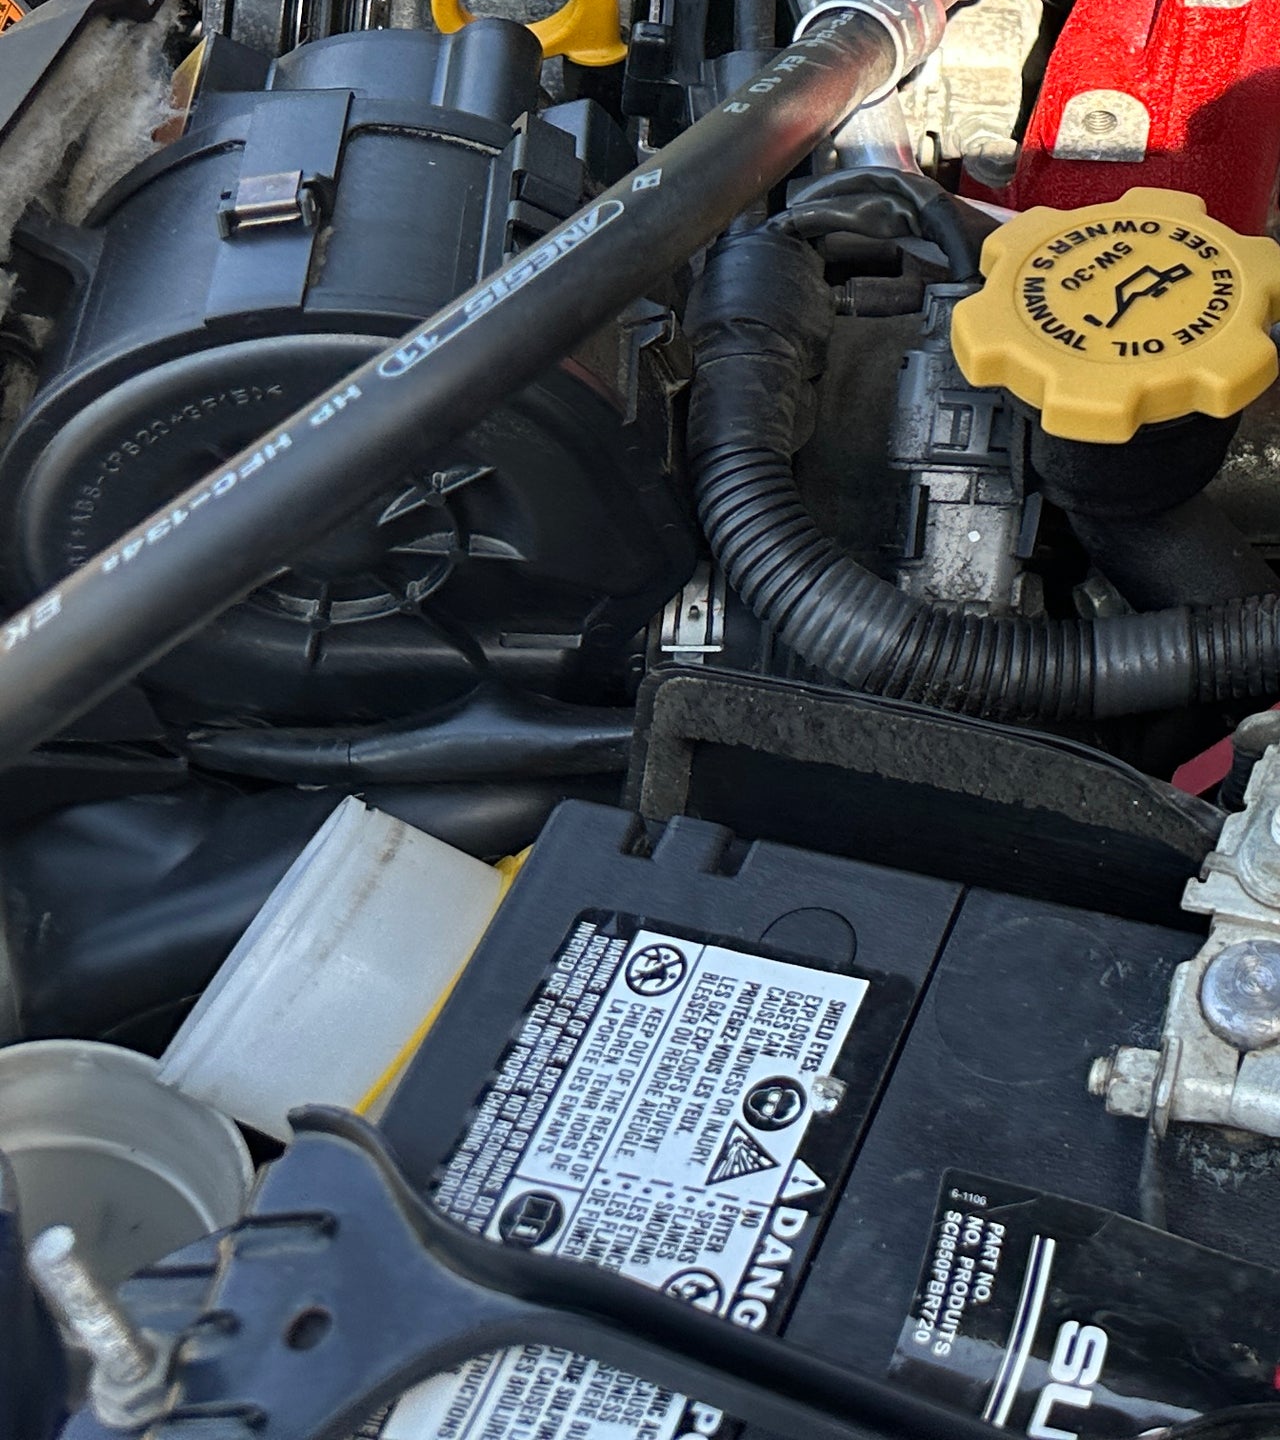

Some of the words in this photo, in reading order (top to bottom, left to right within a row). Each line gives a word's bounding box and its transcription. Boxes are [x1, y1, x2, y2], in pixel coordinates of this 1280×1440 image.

[1032, 220, 1161, 270] OWNER'S
[1168, 227, 1219, 259] SEE
[1023, 276, 1087, 351] MANUAL
[1172, 268, 1232, 345] ENGINE
[1111, 338, 1164, 356] OIL
[306, 381, 362, 429] HP
[99, 430, 294, 575] HFC-134a
[557, 921, 596, 971] INVERTED
[559, 935, 608, 1007] DISASSEMBLE
[712, 976, 738, 999] LES
[549, 1006, 571, 1025] OR
[574, 991, 600, 1018] RISK
[604, 996, 627, 1015] LA
[679, 972, 718, 1026] BLESSER
[701, 1000, 725, 1026] GAZ
[752, 986, 784, 1027] CAUSE
[772, 990, 803, 1030] GASES
[813, 998, 845, 1041] SHIELD
[518, 996, 555, 1046] FOLLOW
[565, 1018, 585, 1036] OF
[598, 1002, 646, 1066] CHILDREN.
[636, 1006, 665, 1039] KEEP
[669, 1026, 693, 1046] OU
[778, 994, 823, 1060] EXPLOSIVE
[622, 1038, 648, 1067] OUT
[667, 1026, 712, 1093] EXPLOSIFS
[719, 1026, 765, 1095] BLINDNESS
[759, 1031, 785, 1058] CAN
[494, 1044, 530, 1091] PROPER
[565, 1065, 590, 1092] DES
[612, 1067, 634, 1088] OF
[644, 1046, 682, 1098] RENDRE
[691, 1075, 716, 1099] LES
[500, 1093, 526, 1120] NOT
[515, 1065, 562, 1131] EXPLOSION
[579, 1071, 611, 1111] TENIR
[599, 1087, 624, 1115] THE
[710, 1095, 733, 1116] OR
[461, 1090, 506, 1152] CHARGING
[532, 1093, 577, 1155] ENFANTS.
[558, 1111, 591, 1152] HORS
[613, 1097, 657, 1159] AVEUGLE.
[639, 1094, 681, 1153] PEUVENT
[673, 1101, 704, 1134] YEUX.
[506, 1130, 528, 1151] OR
[575, 1115, 611, 1162] REACH
[686, 1117, 724, 1165] INJURY.
[452, 1120, 513, 1213] RECOMMENDED
[547, 1152, 570, 1173] DE
[565, 1161, 587, 1184] OF
[471, 1195, 496, 1219] DO
[585, 1187, 610, 1207] DE
[603, 1192, 631, 1218] LES
[623, 1196, 652, 1223] LES
[563, 1208, 600, 1256] FUMER
[629, 1200, 675, 1267] SMOKING
[654, 1204, 695, 1261] FLAMES
[676, 1209, 716, 1265] SPARKS
[739, 1208, 763, 1229] NO
[960, 1215, 983, 1246] NO.
[980, 1221, 1005, 1270] PART
[931, 1255, 974, 1356] PRODUITS
[969, 1270, 994, 1303] NO.
[515, 1366, 559, 1425] CAUSER
[619, 1379, 656, 1427] CAUSE
